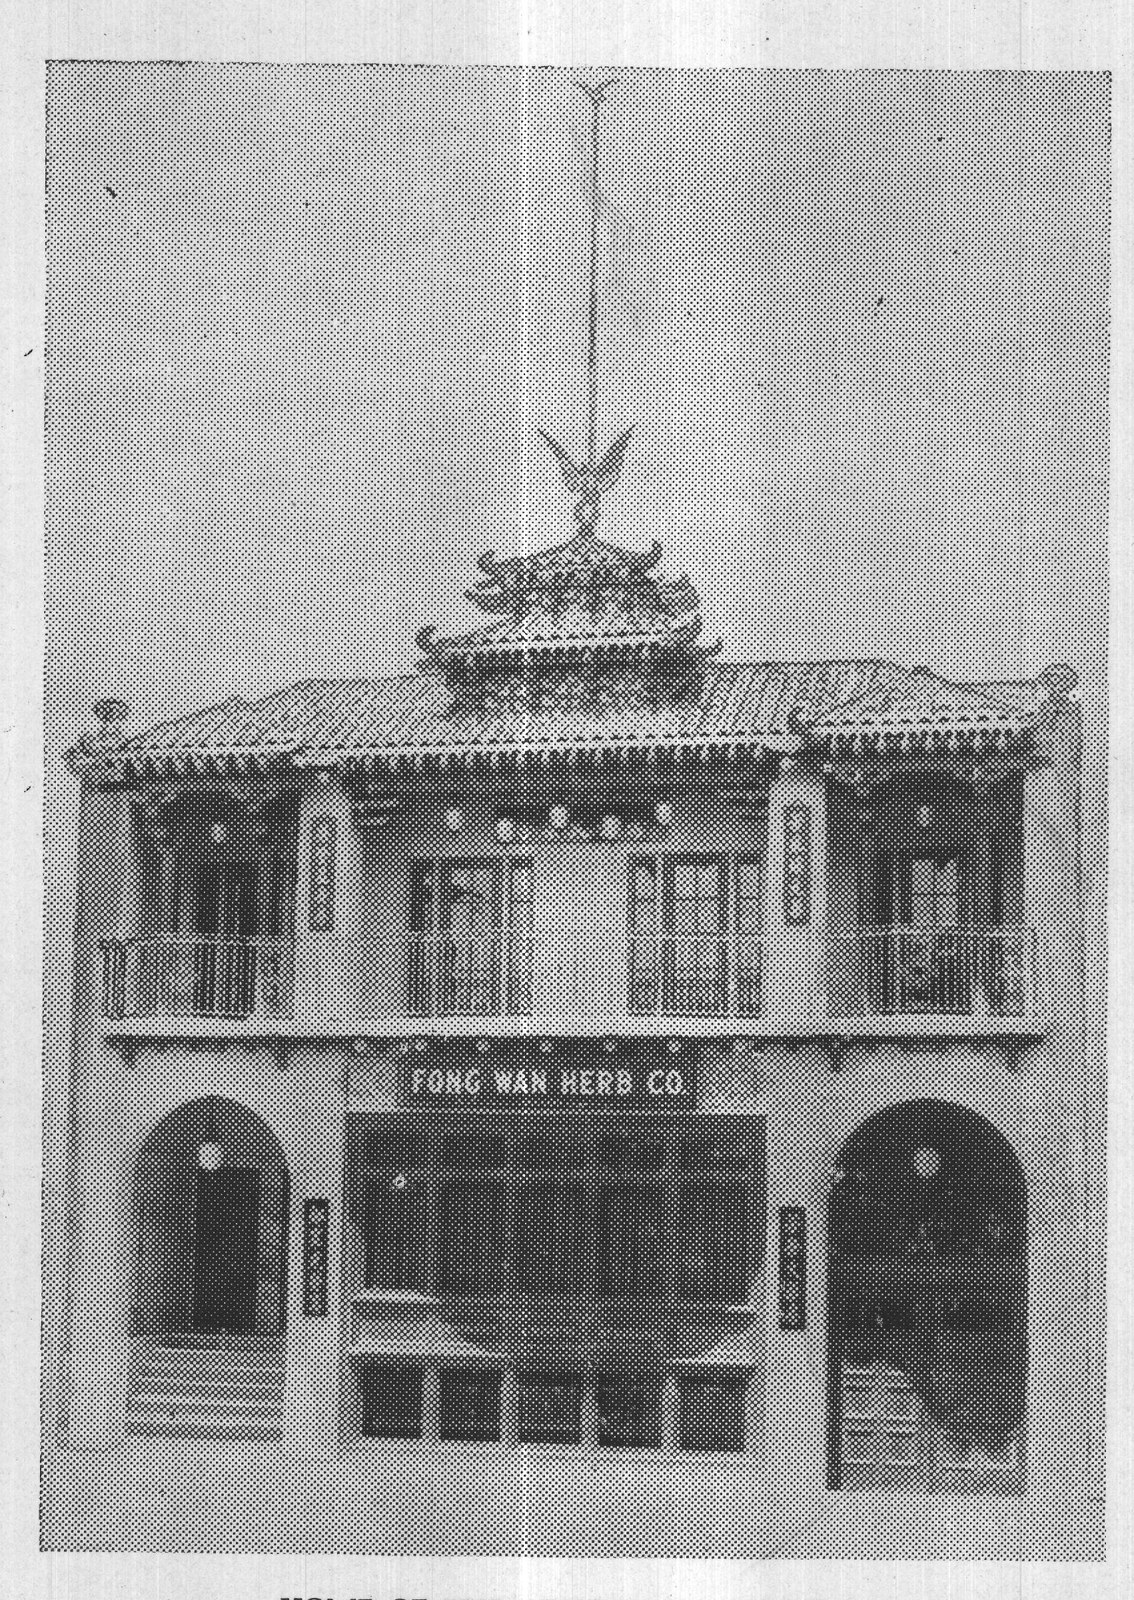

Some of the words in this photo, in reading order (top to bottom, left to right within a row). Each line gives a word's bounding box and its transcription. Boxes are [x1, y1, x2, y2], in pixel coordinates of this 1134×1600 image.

[412, 1068, 480, 1094] FONG
[494, 1069, 547, 1095] WAN
[560, 1069, 633, 1095] HERB
